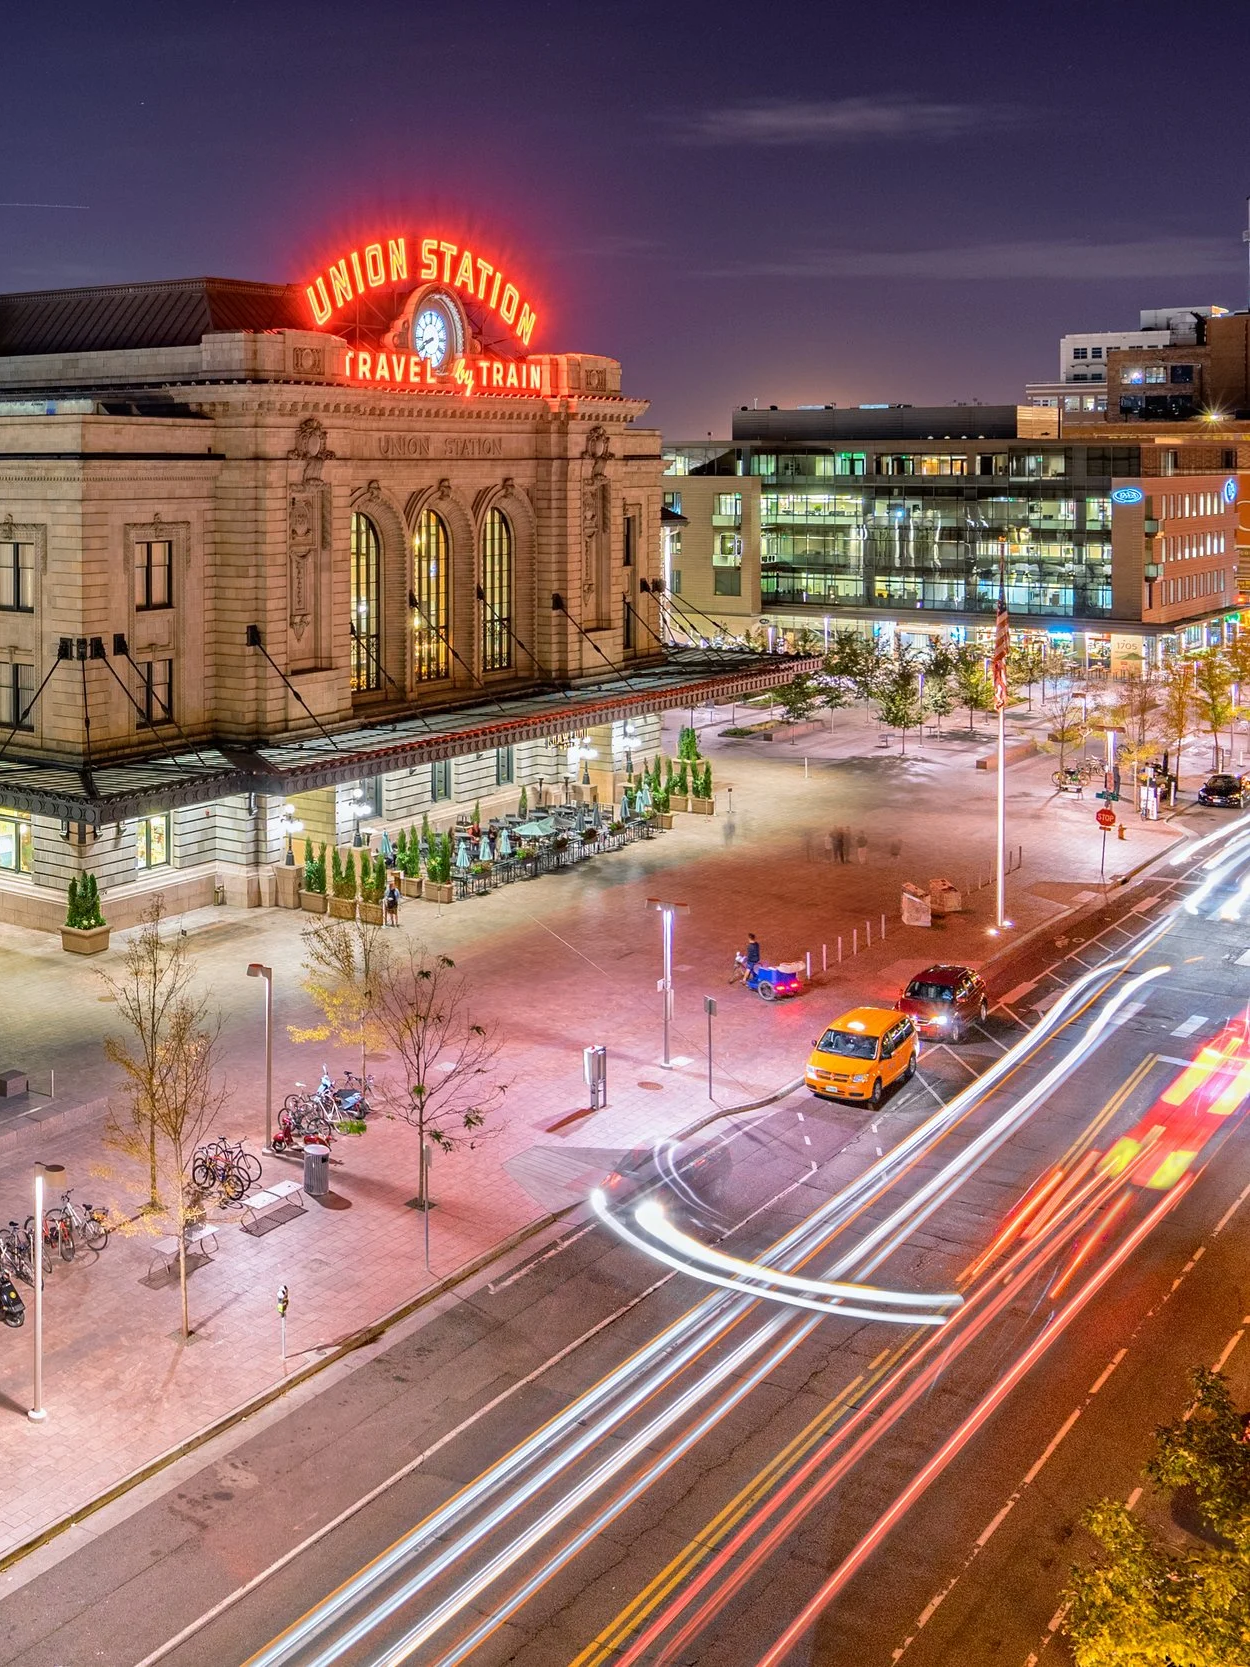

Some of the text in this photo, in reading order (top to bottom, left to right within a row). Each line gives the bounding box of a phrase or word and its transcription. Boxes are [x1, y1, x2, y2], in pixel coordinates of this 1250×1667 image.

[306, 238, 537, 346] UNION STATION
[452, 358, 475, 397] by
[479, 360, 542, 390] TRAIN
[378, 435, 503, 456] UNION STATION
[1117, 642, 1138, 650] 1705
[1097, 814, 1115, 822] STOP
